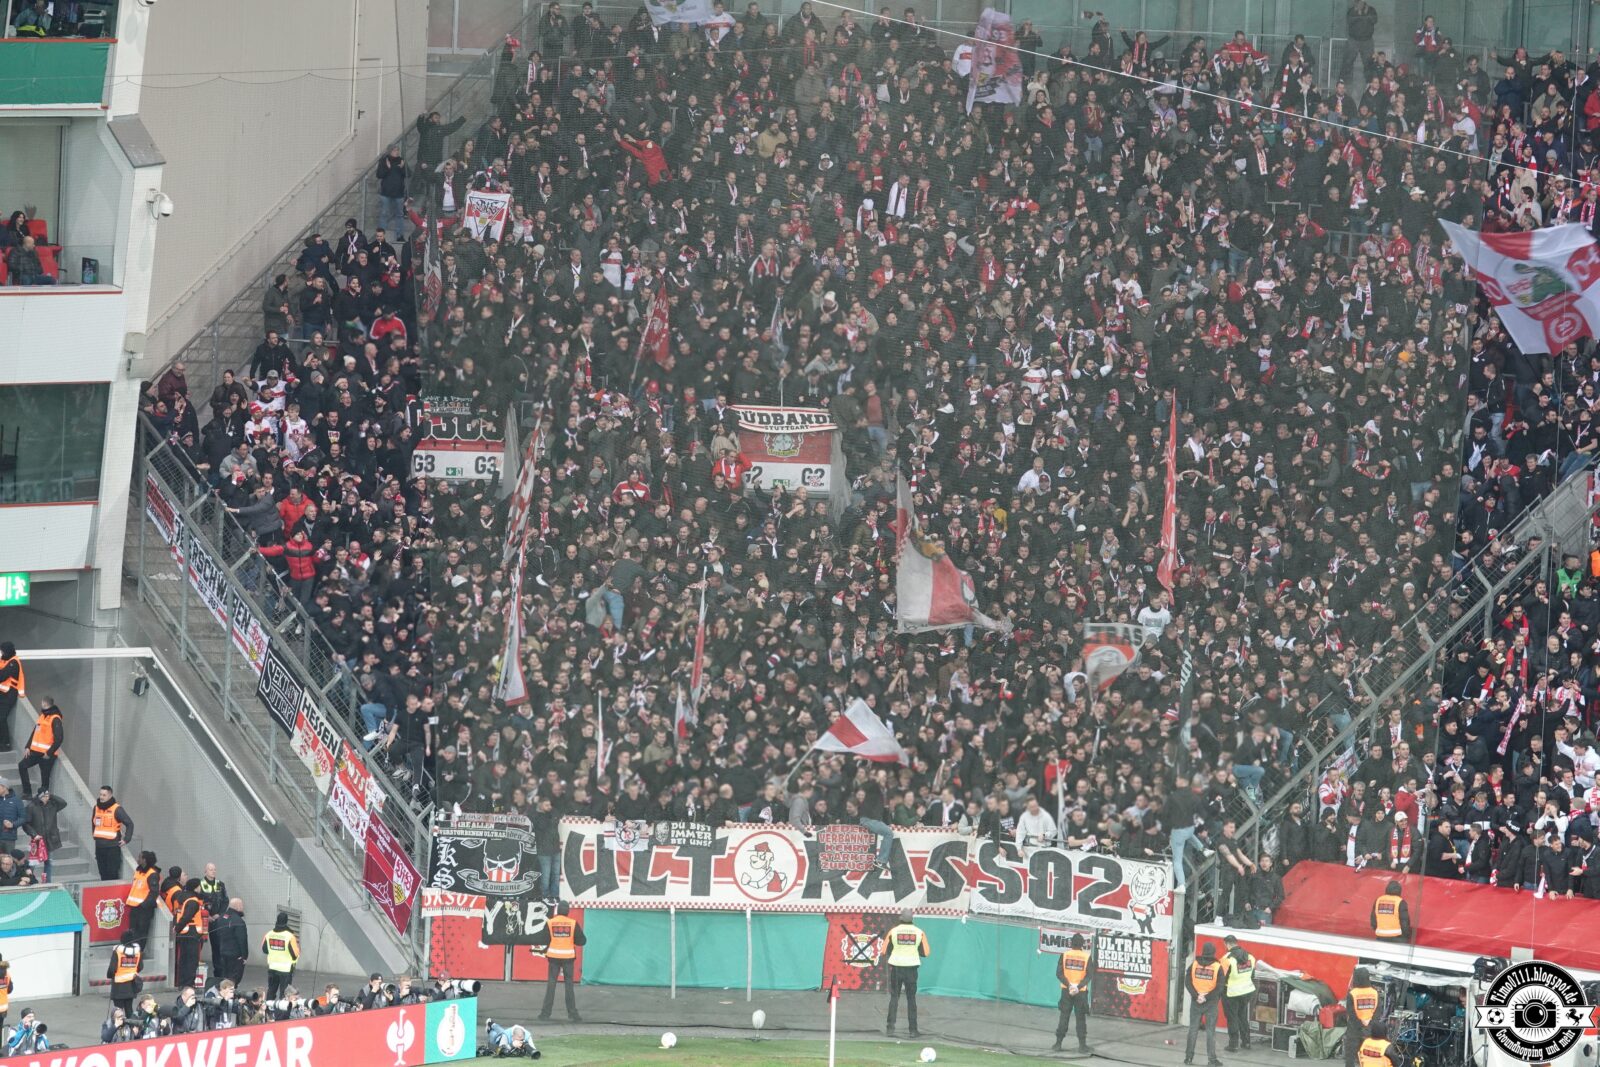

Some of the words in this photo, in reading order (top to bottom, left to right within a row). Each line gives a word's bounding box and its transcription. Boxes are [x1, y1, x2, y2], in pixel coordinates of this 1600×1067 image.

[737, 410, 834, 425] ÜDBAND
[413, 454, 436, 473] G3
[474, 456, 497, 475] G3
[302, 697, 340, 756] HESSEN
[473, 821, 495, 829] ALLEN
[689, 822, 712, 832] BIST
[824, 825, 869, 833] JEDER
[483, 830, 506, 838] ULTRAS
[671, 829, 712, 840] IMMER
[818, 833, 876, 844] VERBANNTE
[689, 839, 712, 847] UNS!
[824, 843, 870, 852] KEHRT
[482, 881, 521, 891] Kompanie
[1098, 936, 1151, 953] ULTRAS
[1098, 949, 1151, 963] BEDEUTET
[1098, 959, 1152, 973] WIDERSTAND
